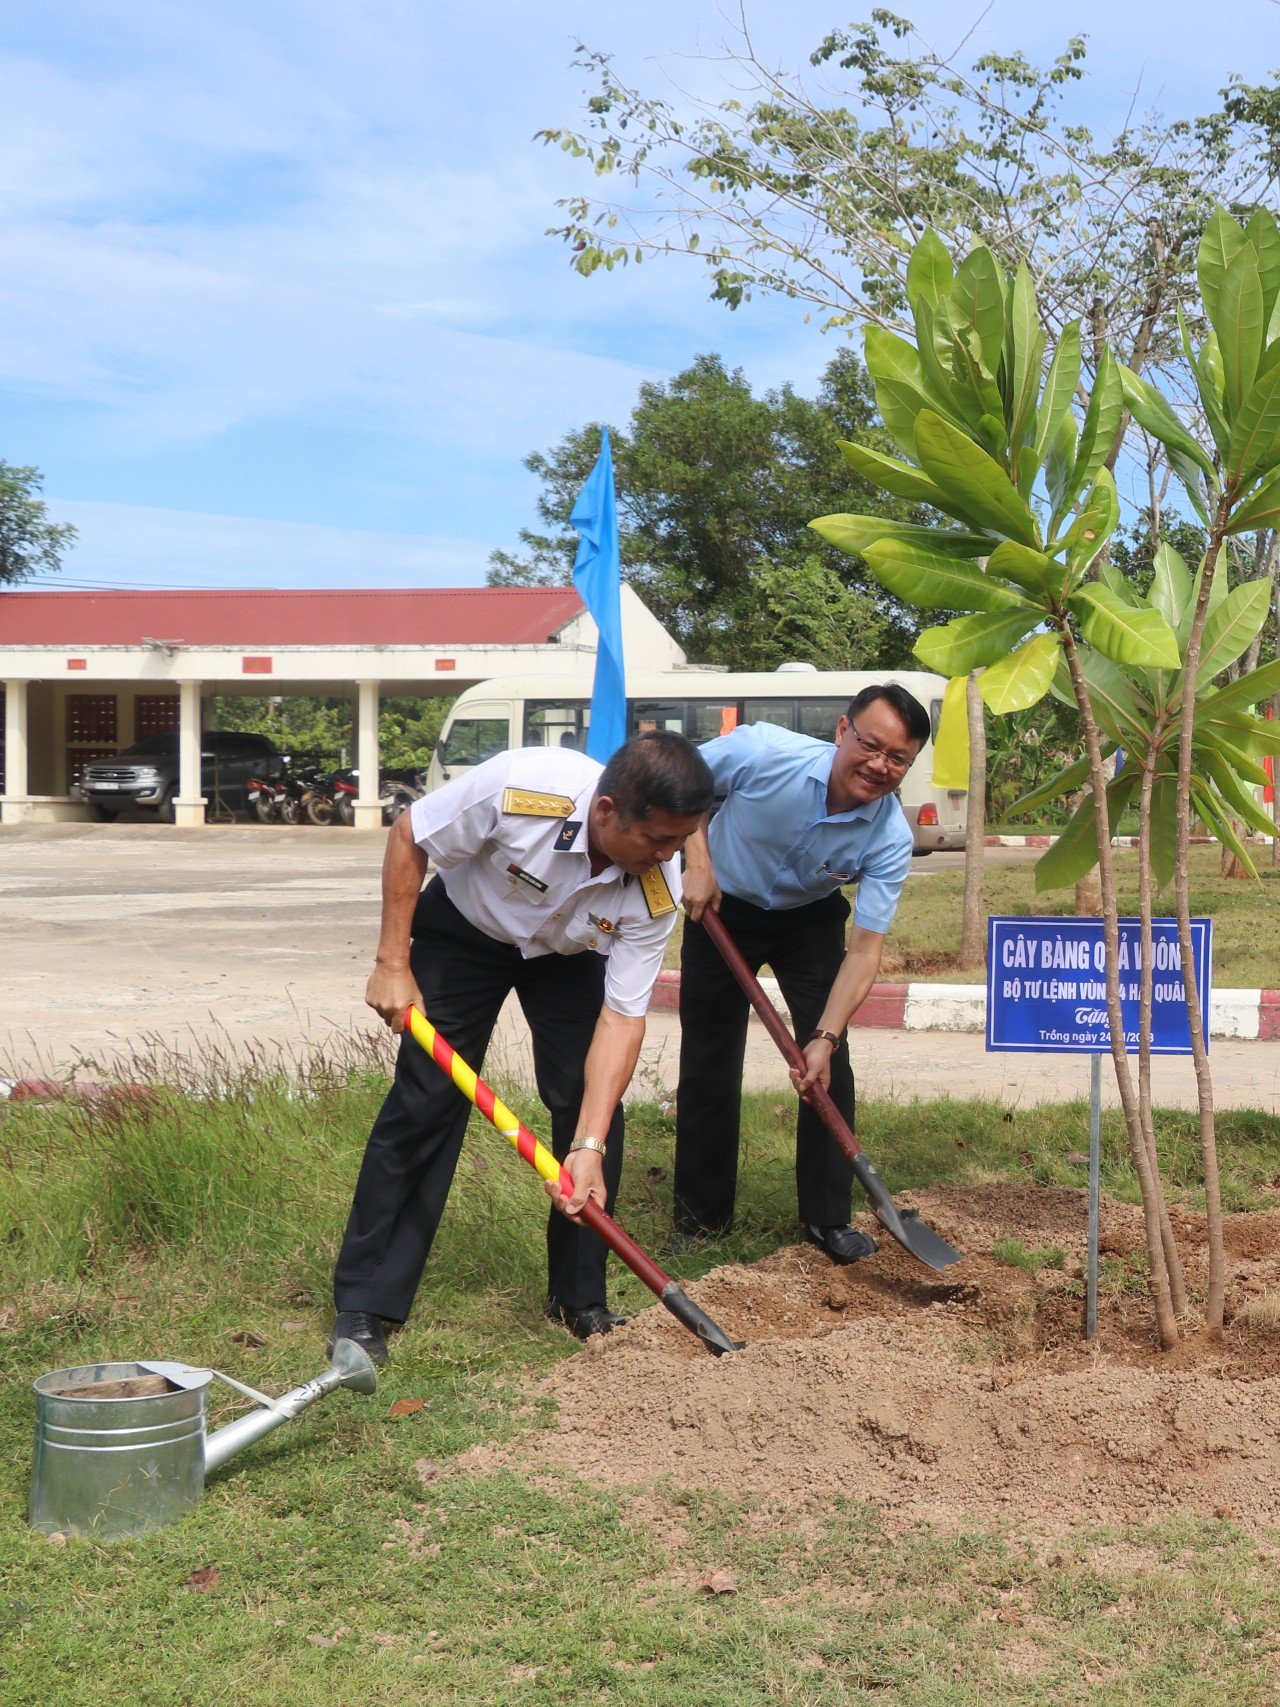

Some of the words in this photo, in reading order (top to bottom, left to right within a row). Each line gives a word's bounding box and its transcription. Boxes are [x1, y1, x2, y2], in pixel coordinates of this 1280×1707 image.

[1002, 933, 1037, 968] CÂY
[1041, 934, 1089, 969] BÀNG
[1094, 932, 1130, 973] QẢ
[1003, 977, 1021, 1002] BỘ
[1024, 979, 1042, 999] TƯ
[1043, 978, 1077, 1003] LỆNH
[1080, 979, 1107, 1000] VÙN
[1072, 1031, 1098, 1044] ngày
